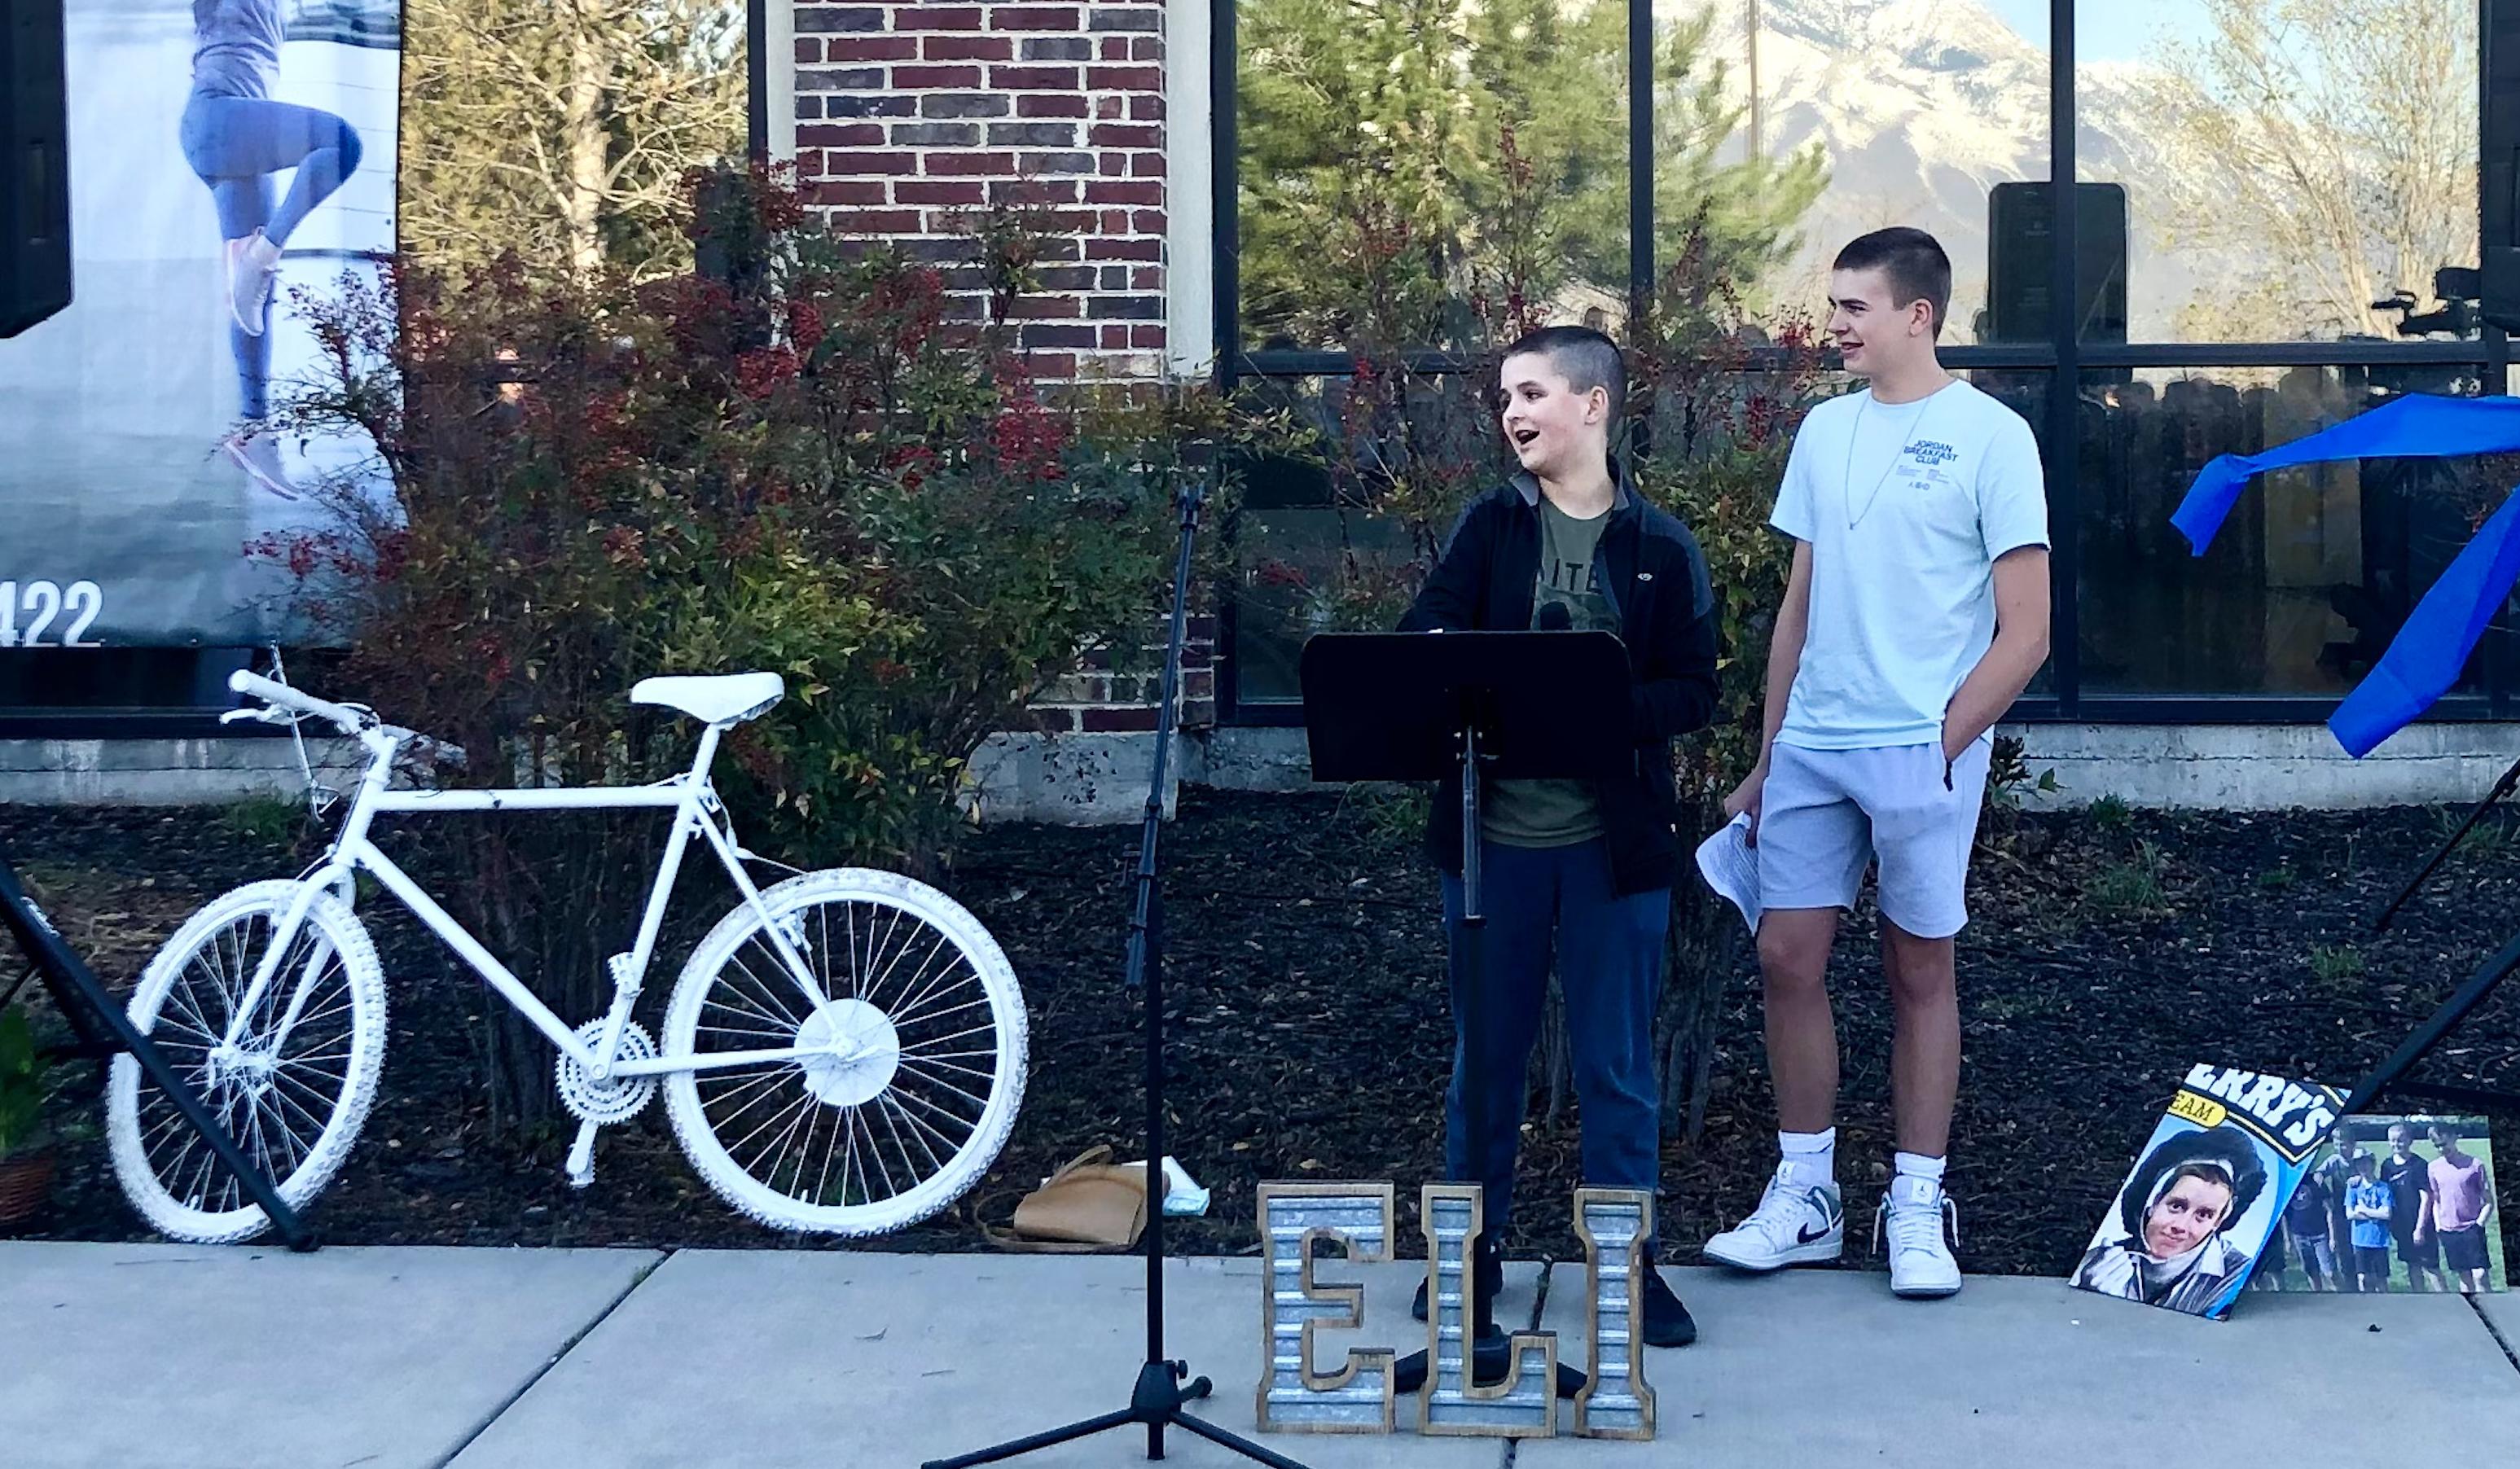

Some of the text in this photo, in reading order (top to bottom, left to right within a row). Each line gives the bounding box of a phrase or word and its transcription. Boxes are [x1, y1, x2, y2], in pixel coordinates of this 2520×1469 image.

[1914, 440, 1953, 453] JORDAN
[1916, 456, 1939, 465] CLUB
[1257, 1180, 1656, 1440] ELI
